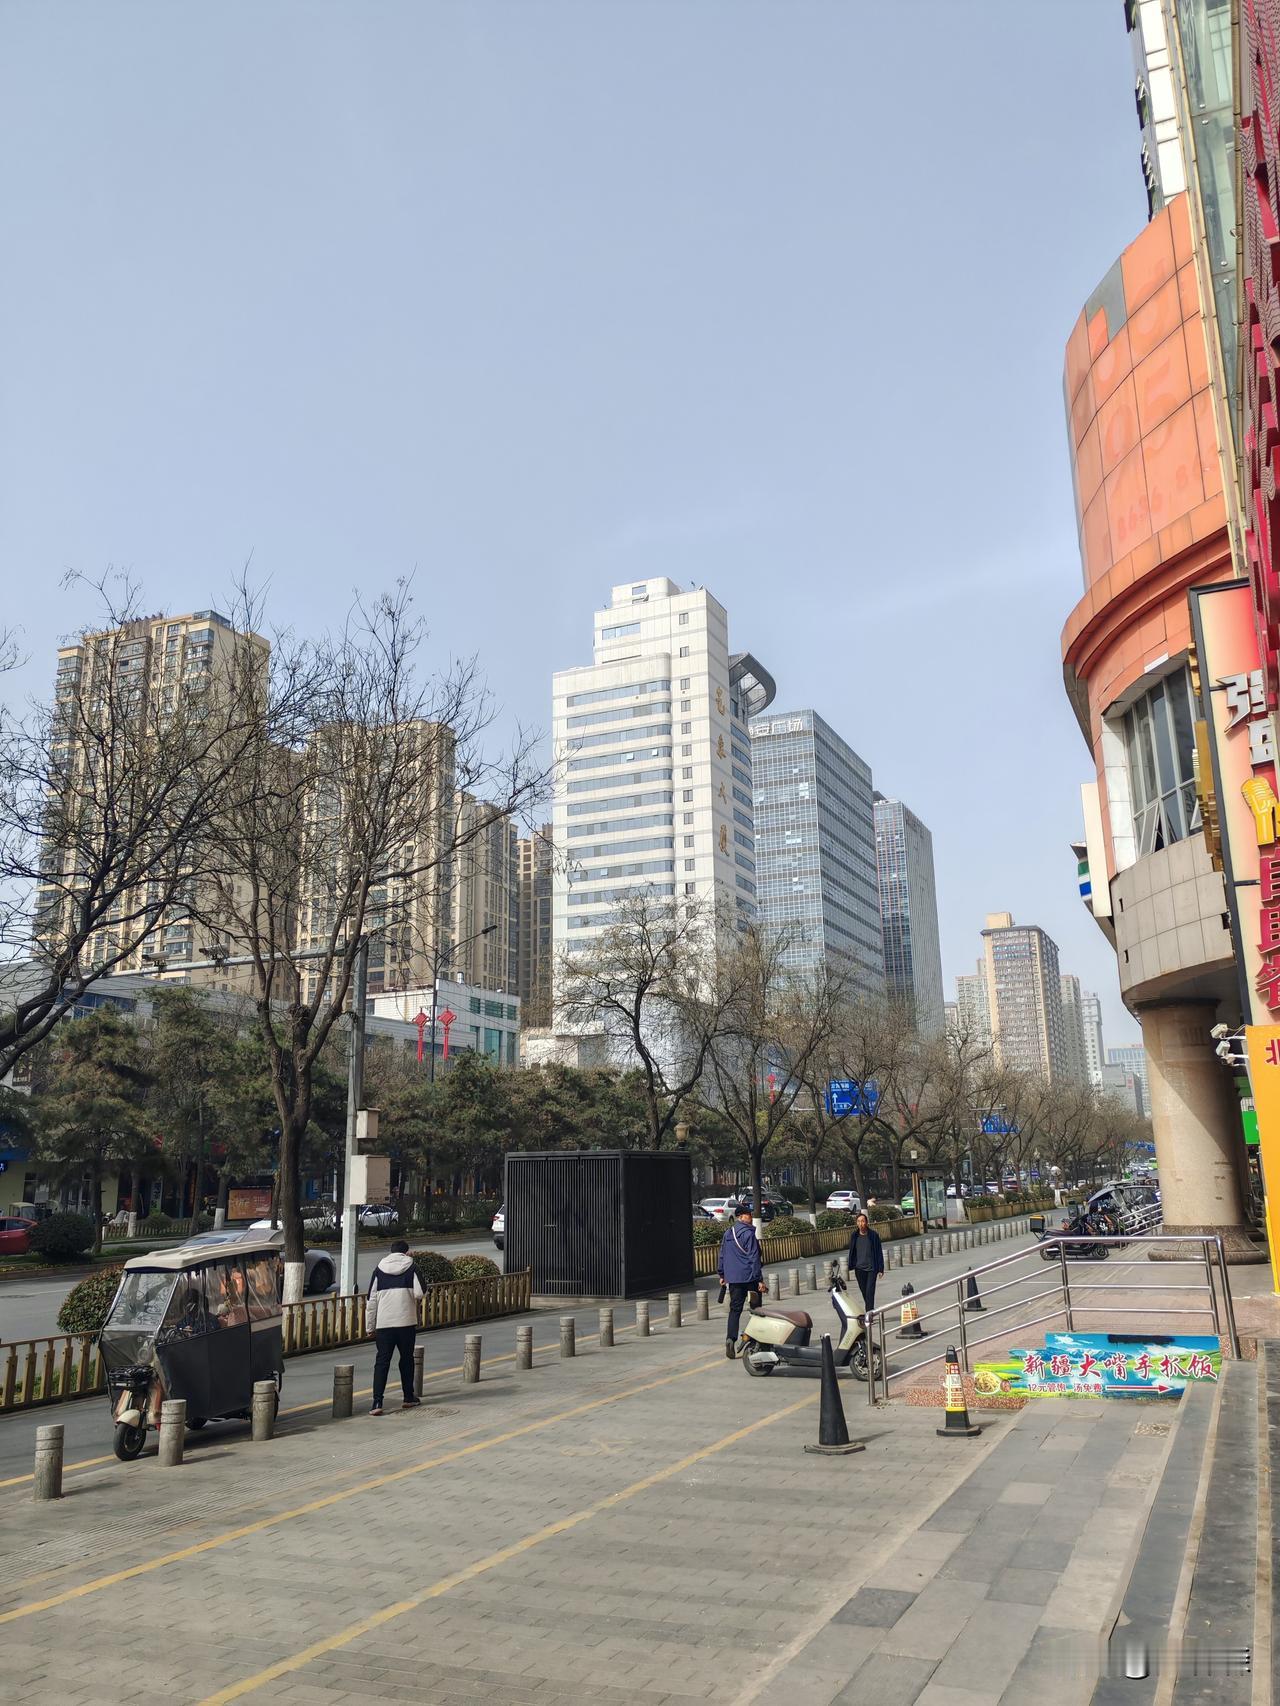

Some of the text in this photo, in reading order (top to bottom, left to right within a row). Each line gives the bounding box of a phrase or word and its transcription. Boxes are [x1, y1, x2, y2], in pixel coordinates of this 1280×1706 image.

[1023, 1353, 1218, 1381] 新疆大嘴手抓饭
[1028, 1383, 1103, 1392] 12元管饱 汤免费
